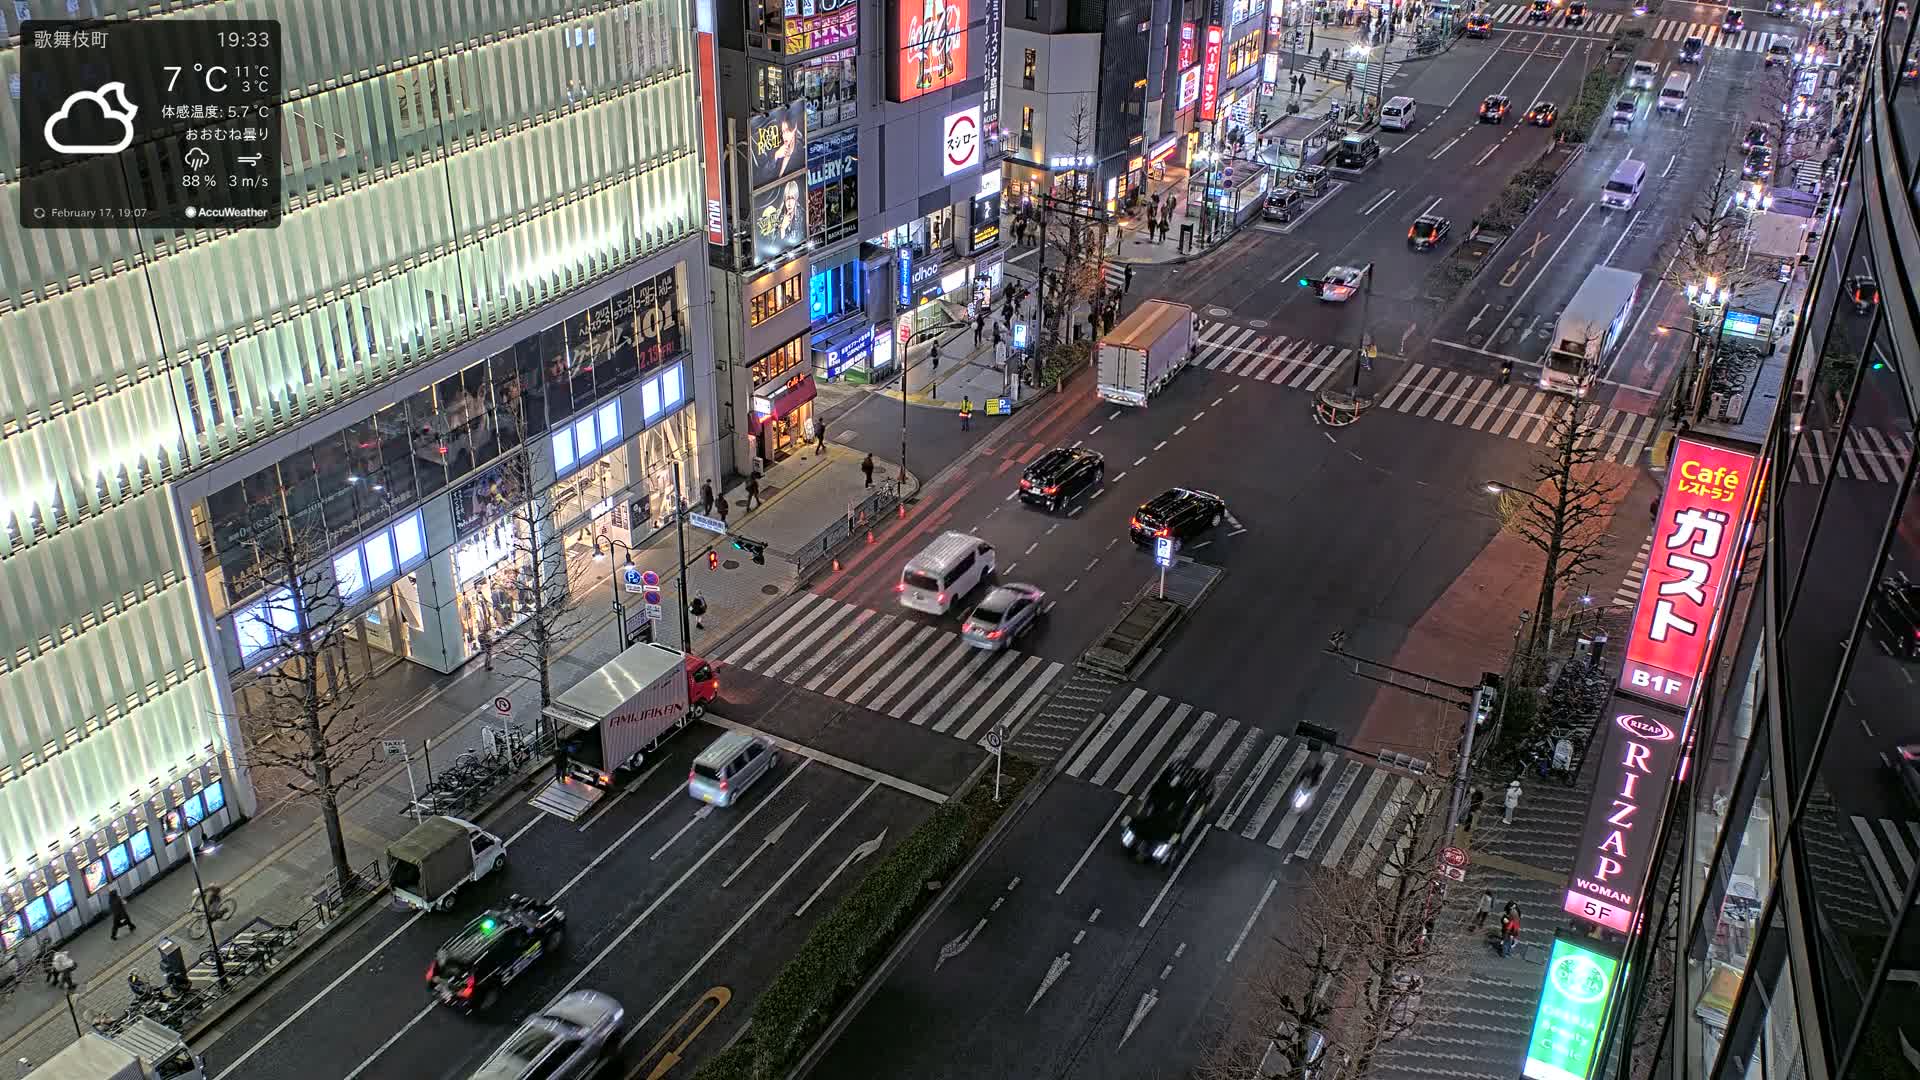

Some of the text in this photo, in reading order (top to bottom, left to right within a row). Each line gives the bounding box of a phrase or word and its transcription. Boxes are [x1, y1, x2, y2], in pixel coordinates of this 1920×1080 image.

[1202, 46, 1219, 111] バーガーキング
[947, 133, 978, 151] スシロー
[808, 155, 852, 186] ALLERY-2
[709, 199, 721, 233] MUJI
[1681, 460, 1739, 490] Café
[1678, 479, 1735, 502] レストラン
[1650, 507, 1730, 642] ガスト
[1631, 670, 1682, 696] B1F
[1630, 720, 1662, 735] RIZAP
[1594, 741, 1652, 882] RIZAP
[1576, 878, 1631, 905] WOMAN
[1583, 902, 1612, 920] 5F
